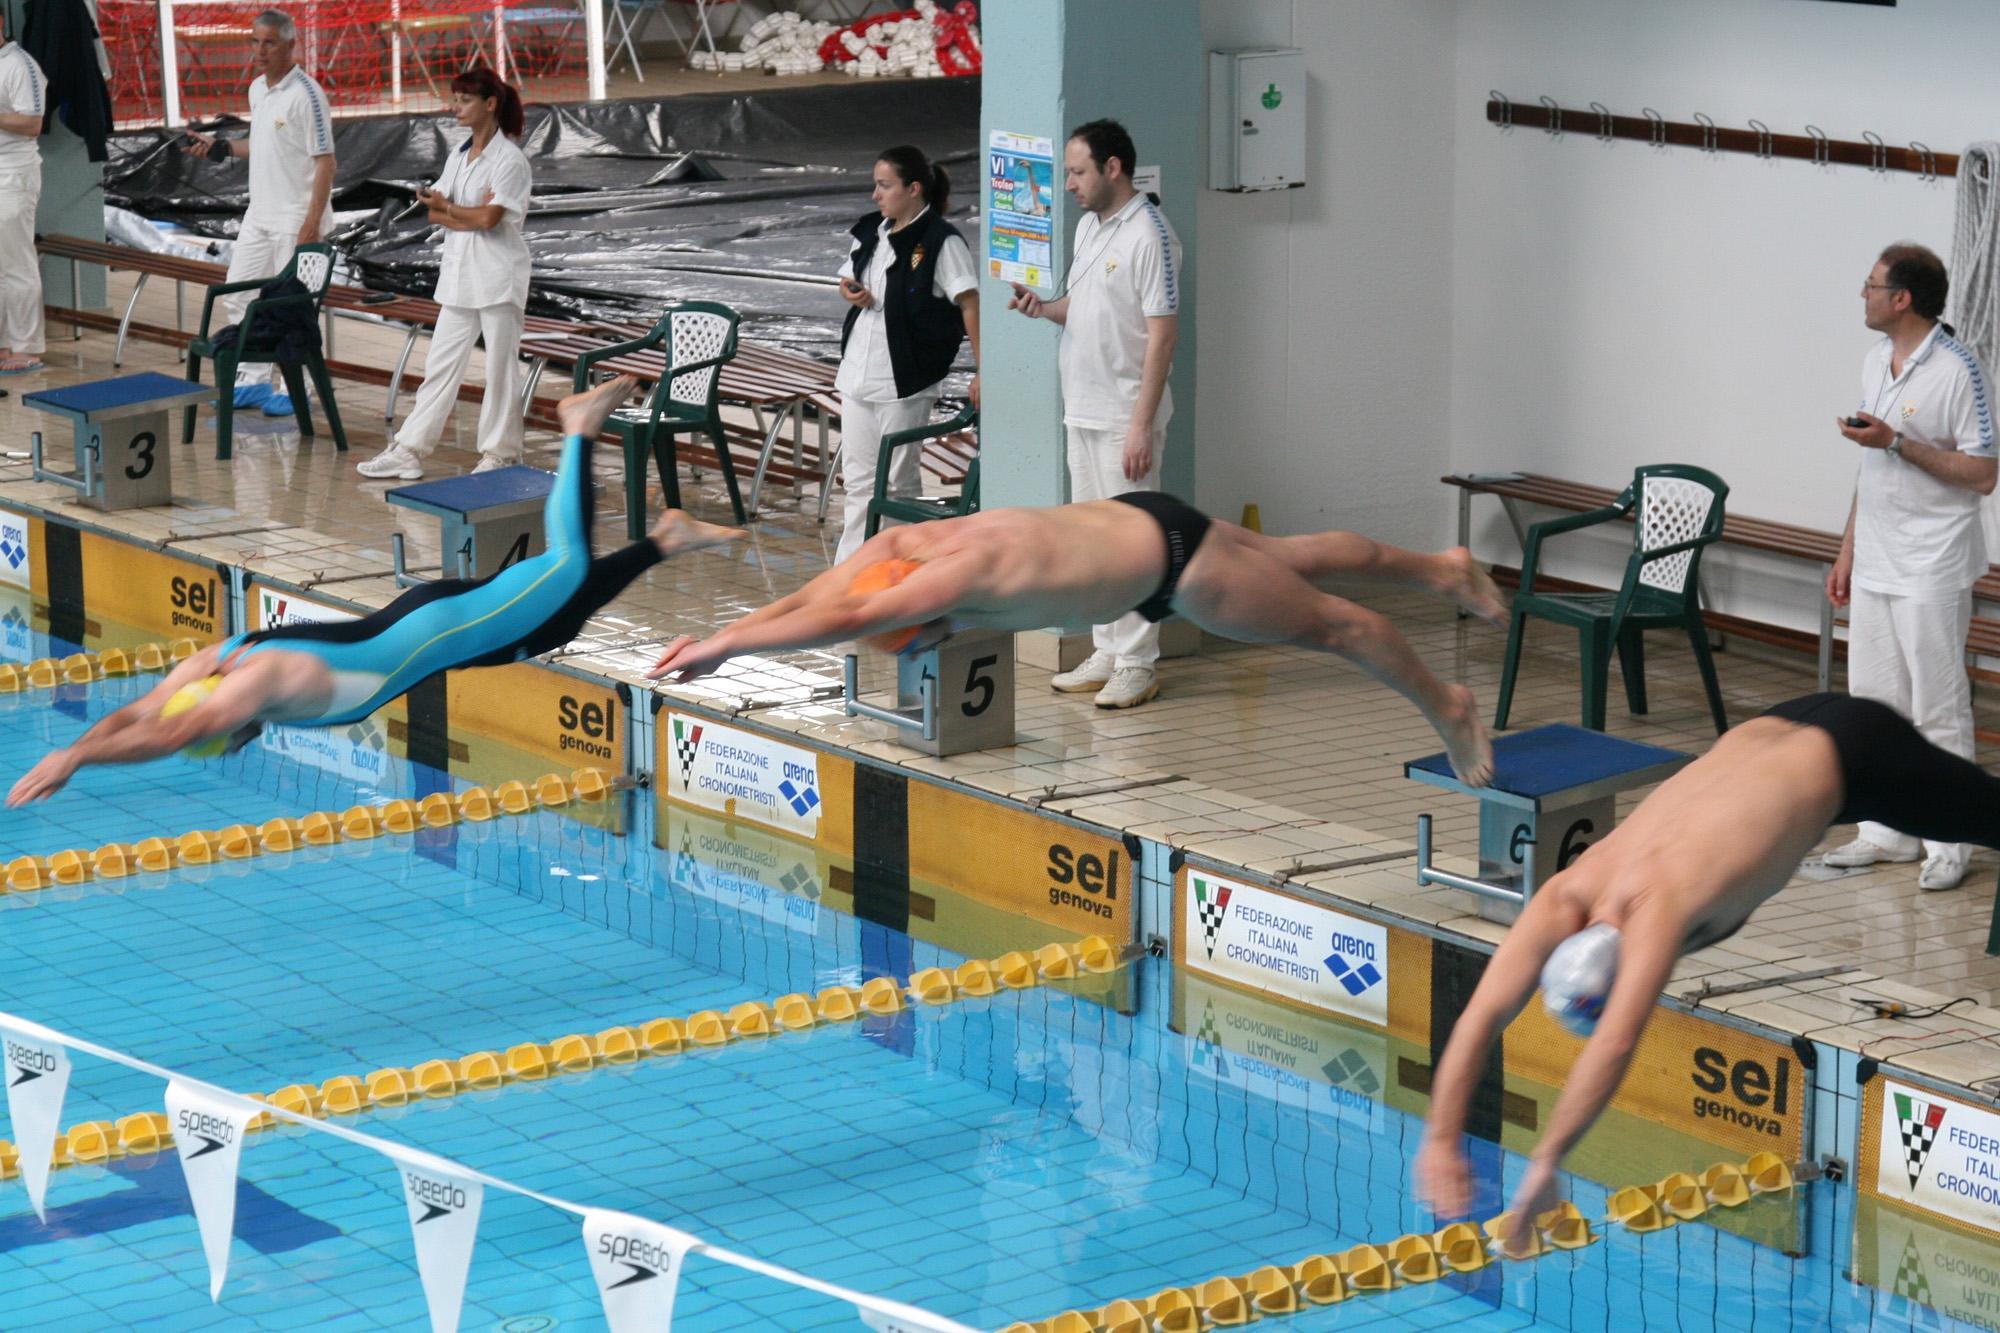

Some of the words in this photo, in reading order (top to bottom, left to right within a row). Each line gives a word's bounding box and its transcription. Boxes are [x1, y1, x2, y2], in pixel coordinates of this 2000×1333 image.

[991, 156, 1005, 175] VI
[991, 177, 1014, 191] Trofeo
[125, 431, 156, 480] 3
[2, 524, 22, 543] arena
[170, 575, 216, 618] sel
[171, 610, 213, 634] genova
[961, 654, 997, 717] 5
[558, 695, 615, 742] sel
[559, 733, 612, 759] genova
[704, 740, 769, 770] FEDERAZIONE
[715, 761, 759, 784] ITALIANA
[783, 760, 815, 786] arena
[698, 776, 776, 806] CRONOMETRISTI
[1509, 823, 1532, 864] 6
[1556, 818, 1594, 873] 6
[1046, 843, 1119, 900] sel
[1048, 887, 1113, 919] genova
[1234, 904, 1313, 941] FEDERAZIONE
[1248, 929, 1299, 957] ITALIANA
[1331, 931, 1375, 961] arena
[1226, 944, 1319, 984] CRONOMETRISTI
[7, 1041, 57, 1073] speedo
[1691, 1046, 1791, 1117] sel
[178, 1107, 234, 1145] speedo
[1692, 1096, 1782, 1137] genova
[1949, 1126, 2000, 1158] FEDER
[1966, 1156, 2000, 1181] ITAL
[405, 1171, 467, 1210] speedo
[597, 1229, 671, 1273] speedo
